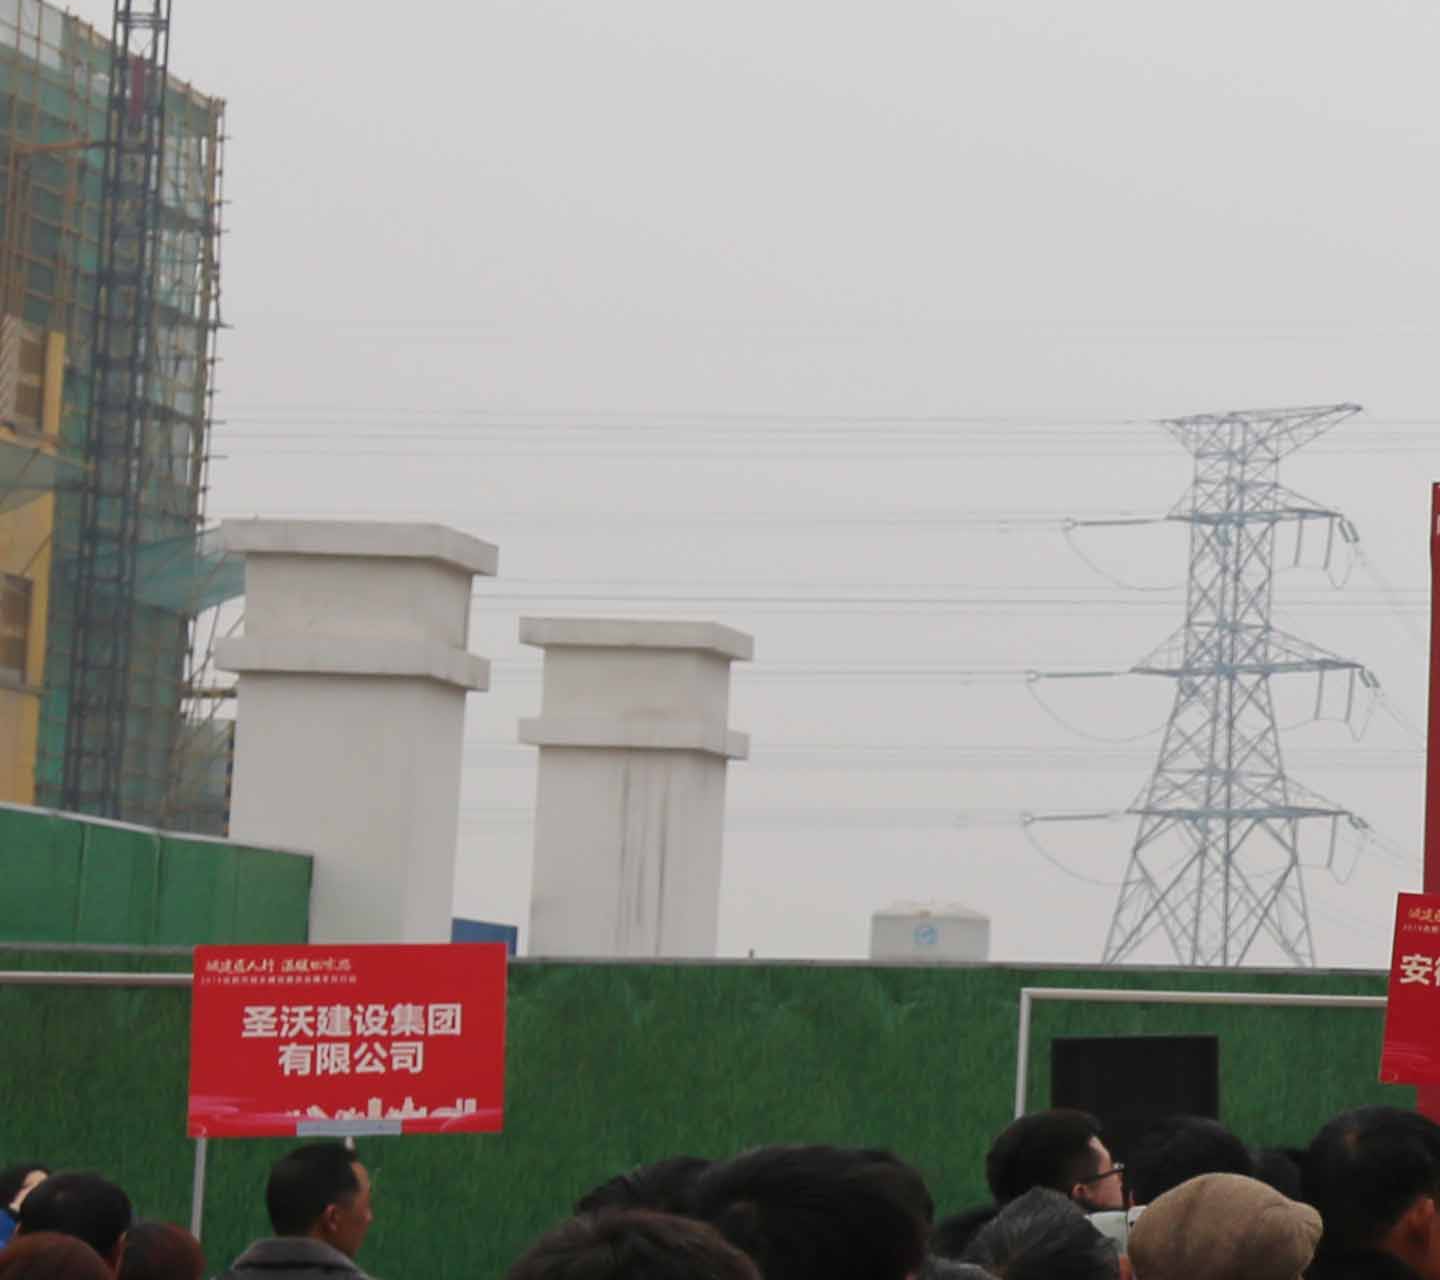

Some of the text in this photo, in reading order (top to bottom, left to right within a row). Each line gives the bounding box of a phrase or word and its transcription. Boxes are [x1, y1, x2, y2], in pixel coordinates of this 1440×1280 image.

[241, 1003, 462, 1038] 圣沃建设集团
[278, 1041, 424, 1076] 有限公司
